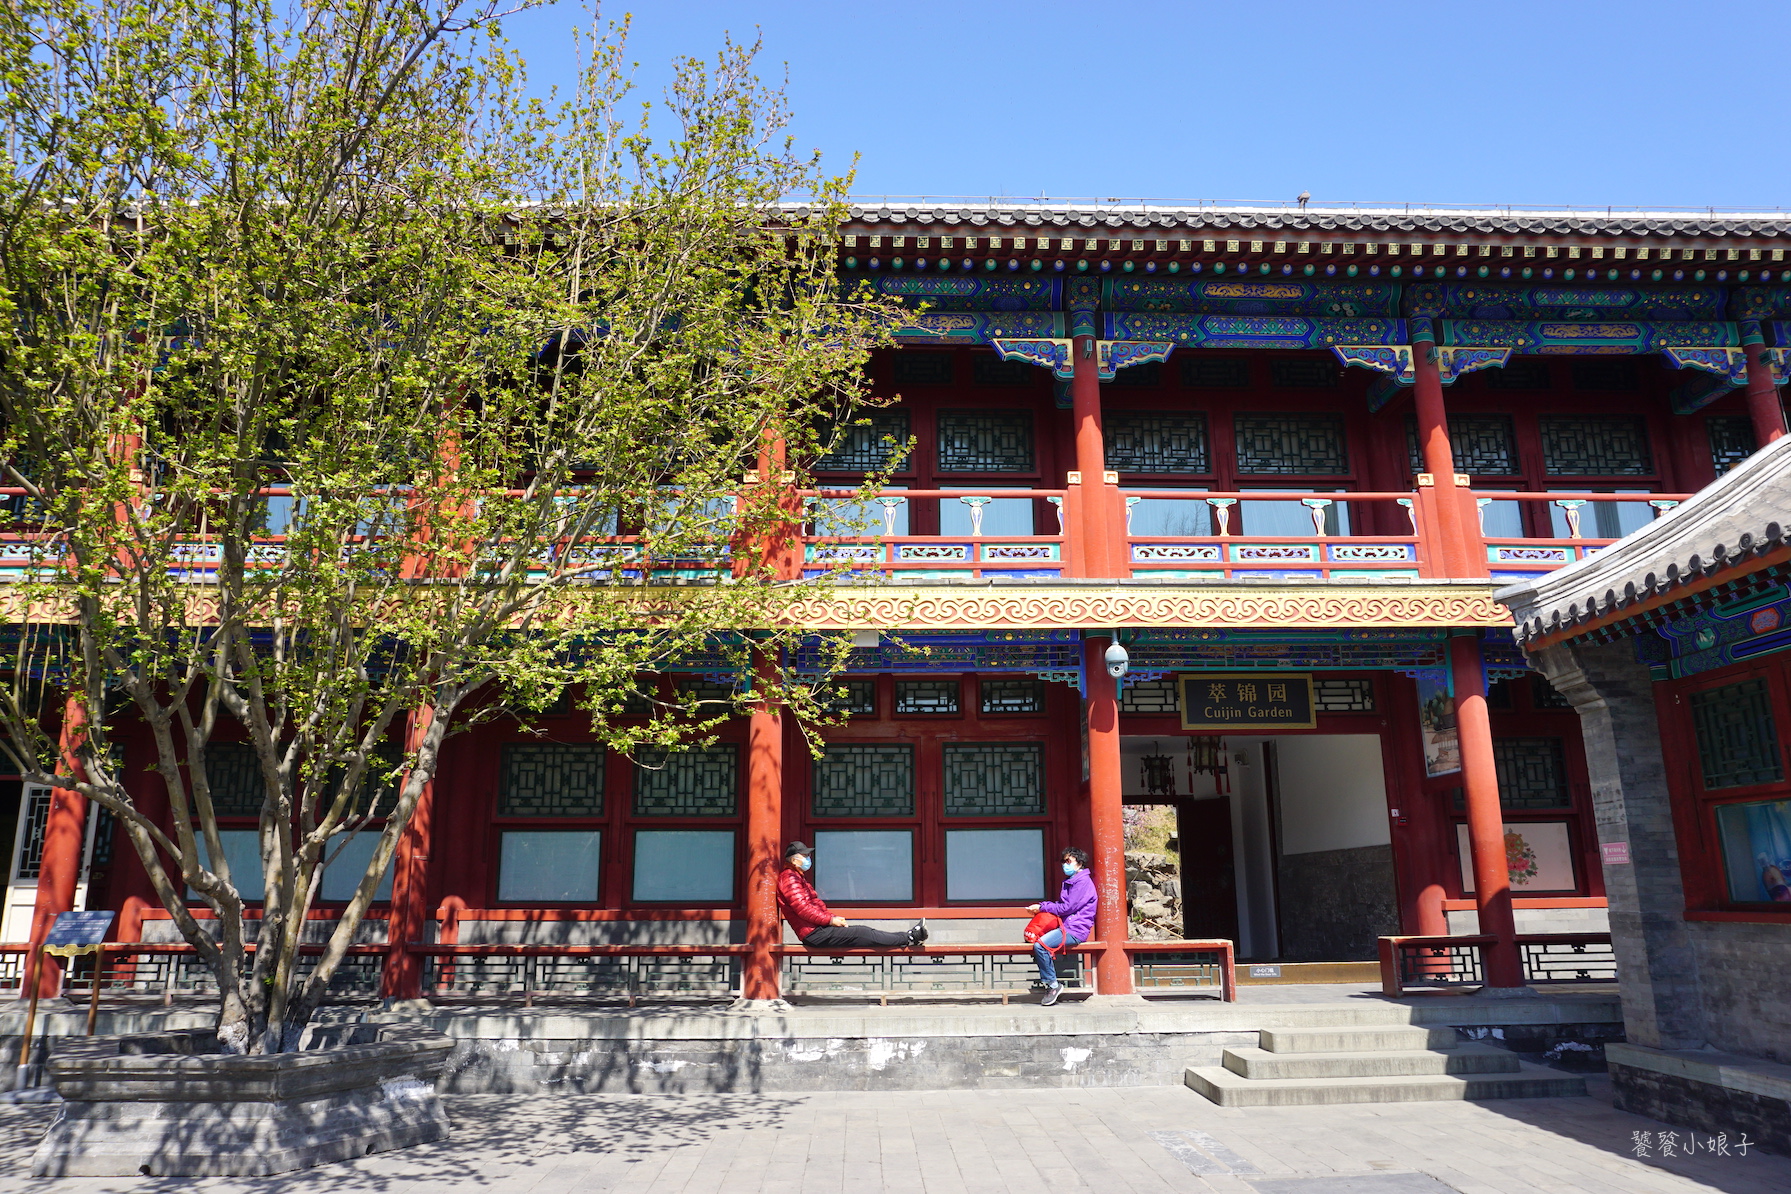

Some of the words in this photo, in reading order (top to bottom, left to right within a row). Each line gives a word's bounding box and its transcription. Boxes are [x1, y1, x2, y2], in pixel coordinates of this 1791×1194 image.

[1207, 683, 1287, 703] 萃锦园
[1204, 706, 1242, 720] Cuijin
[1247, 706, 1293, 718] Garden
